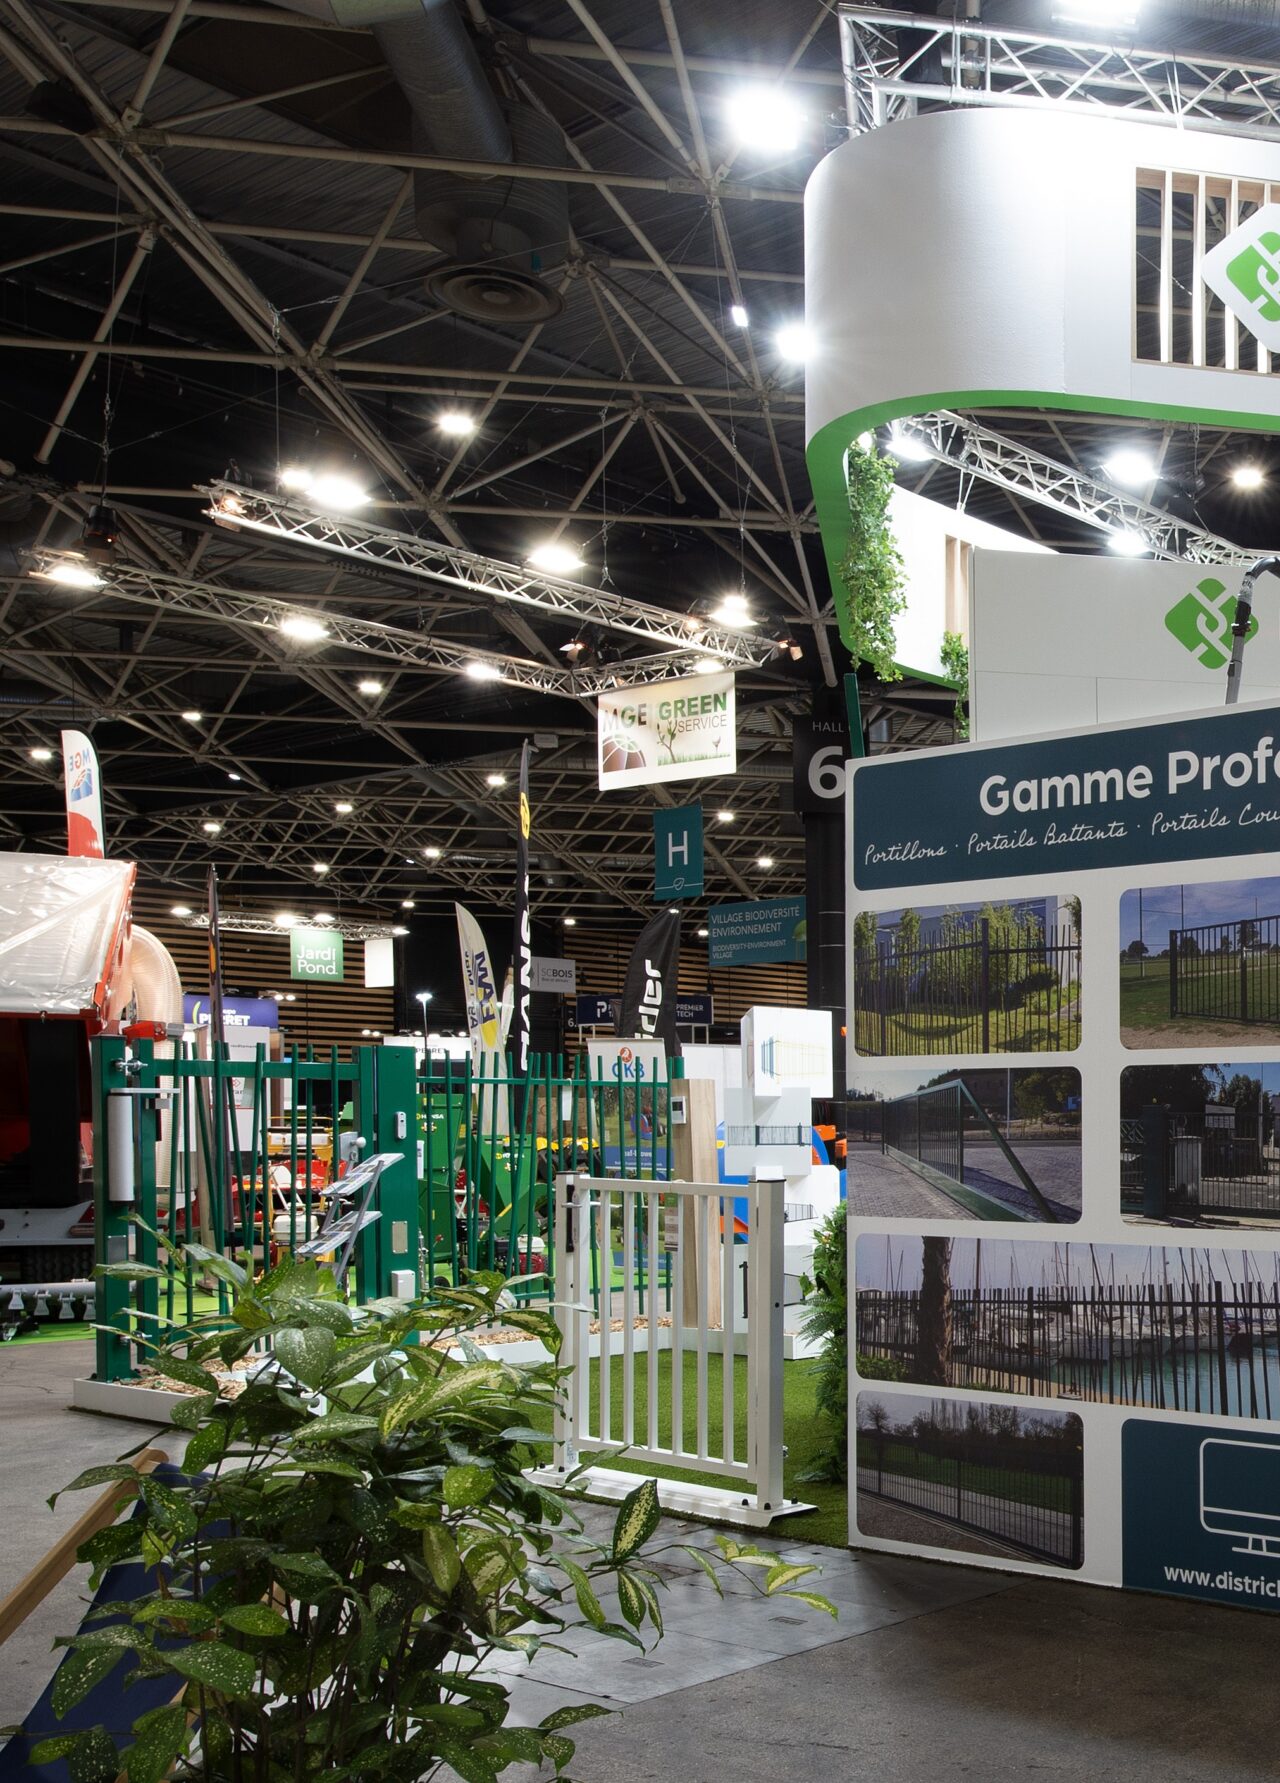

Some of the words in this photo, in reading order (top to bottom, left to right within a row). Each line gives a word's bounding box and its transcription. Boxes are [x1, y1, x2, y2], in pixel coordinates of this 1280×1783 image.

[603, 703, 647, 732] MGE
[659, 692, 727, 720] GREEN
[678, 714, 727, 733] SERVICE
[812, 721, 844, 733] HALL
[808, 746, 846, 799] 6
[980, 765, 1153, 816] Gamme
[668, 831, 688, 867] H
[865, 844, 947, 866] Portillons
[968, 830, 1037, 855] Portails
[1043, 822, 1128, 846] Battants
[1152, 808, 1230, 835] Portails
[711, 910, 744, 924] VILLAGE
[745, 905, 800, 921] BIODIVERSITÉ
[712, 922, 782, 937] ENVIRONNEMENT
[712, 951, 733, 960] VILLAGE
